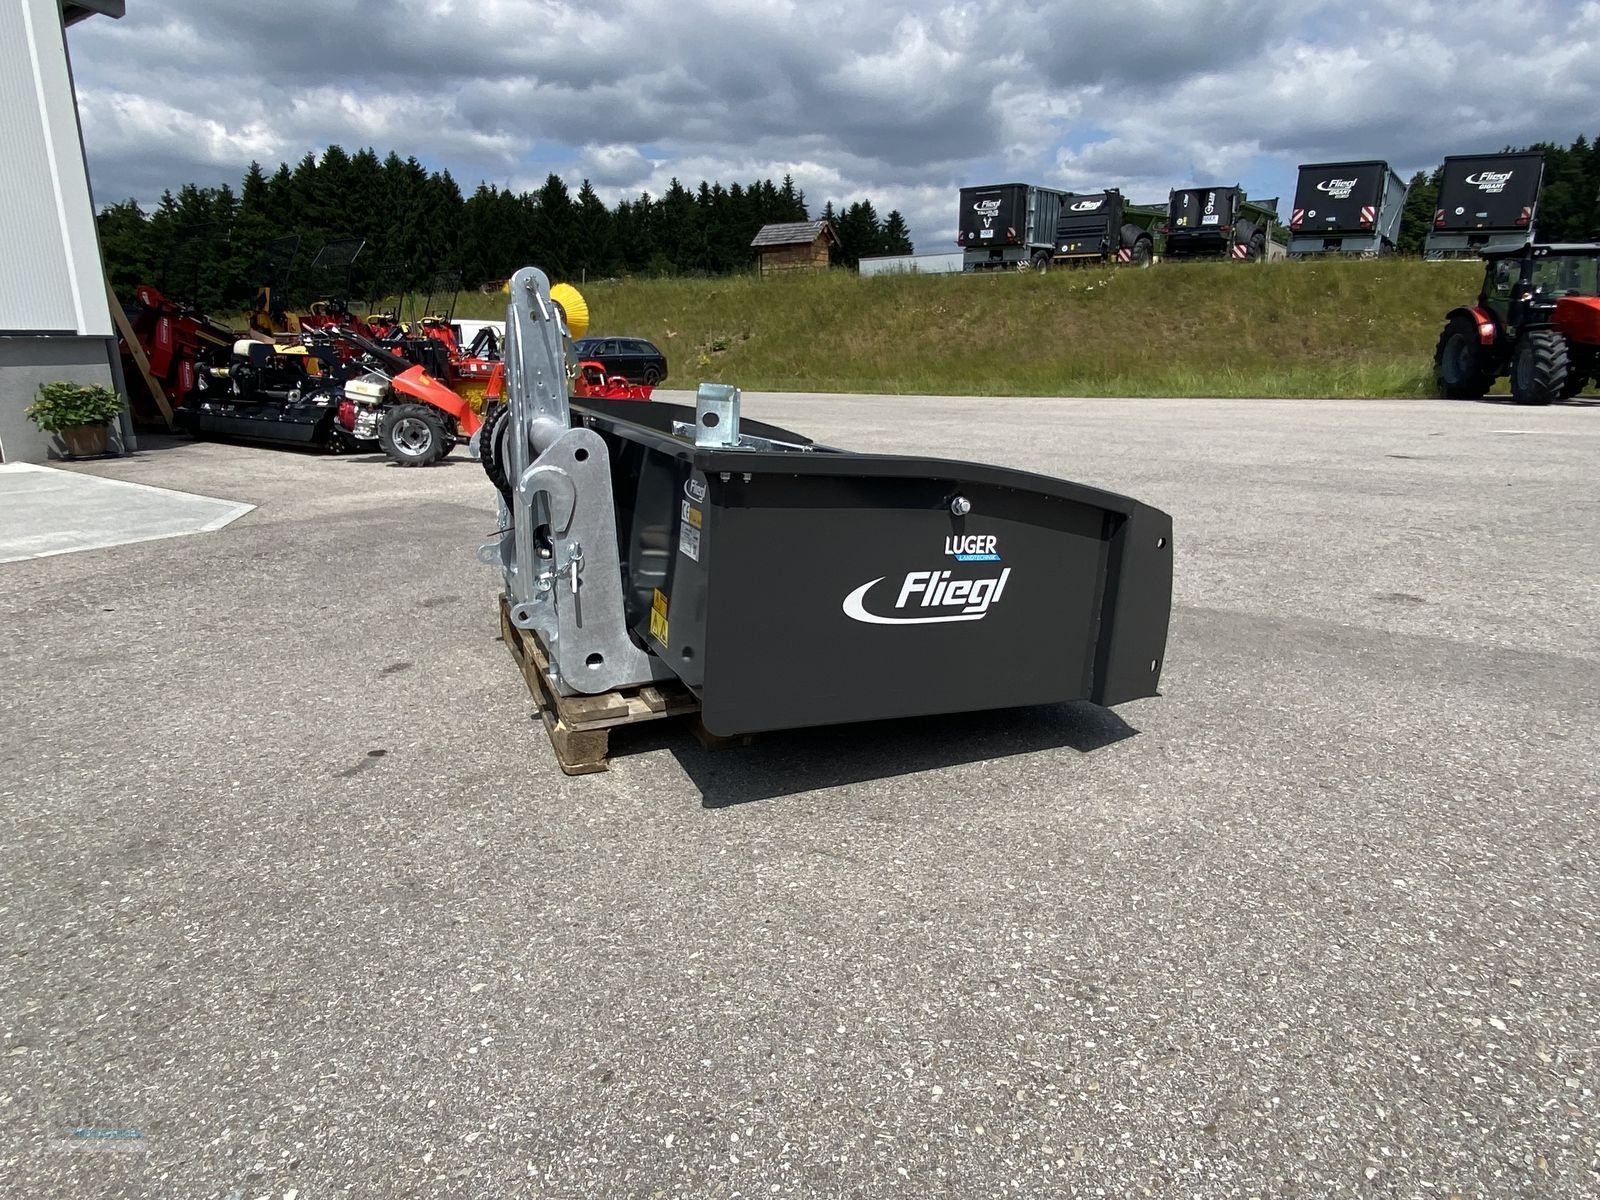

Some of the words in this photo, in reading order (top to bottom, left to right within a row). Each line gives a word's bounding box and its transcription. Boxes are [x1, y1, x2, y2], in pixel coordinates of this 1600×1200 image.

[1328, 177, 1358, 189] Fliegl
[1479, 170, 1514, 181] Fliegl
[944, 535, 997, 555] LUGER
[894, 567, 1012, 614] Fliegl
